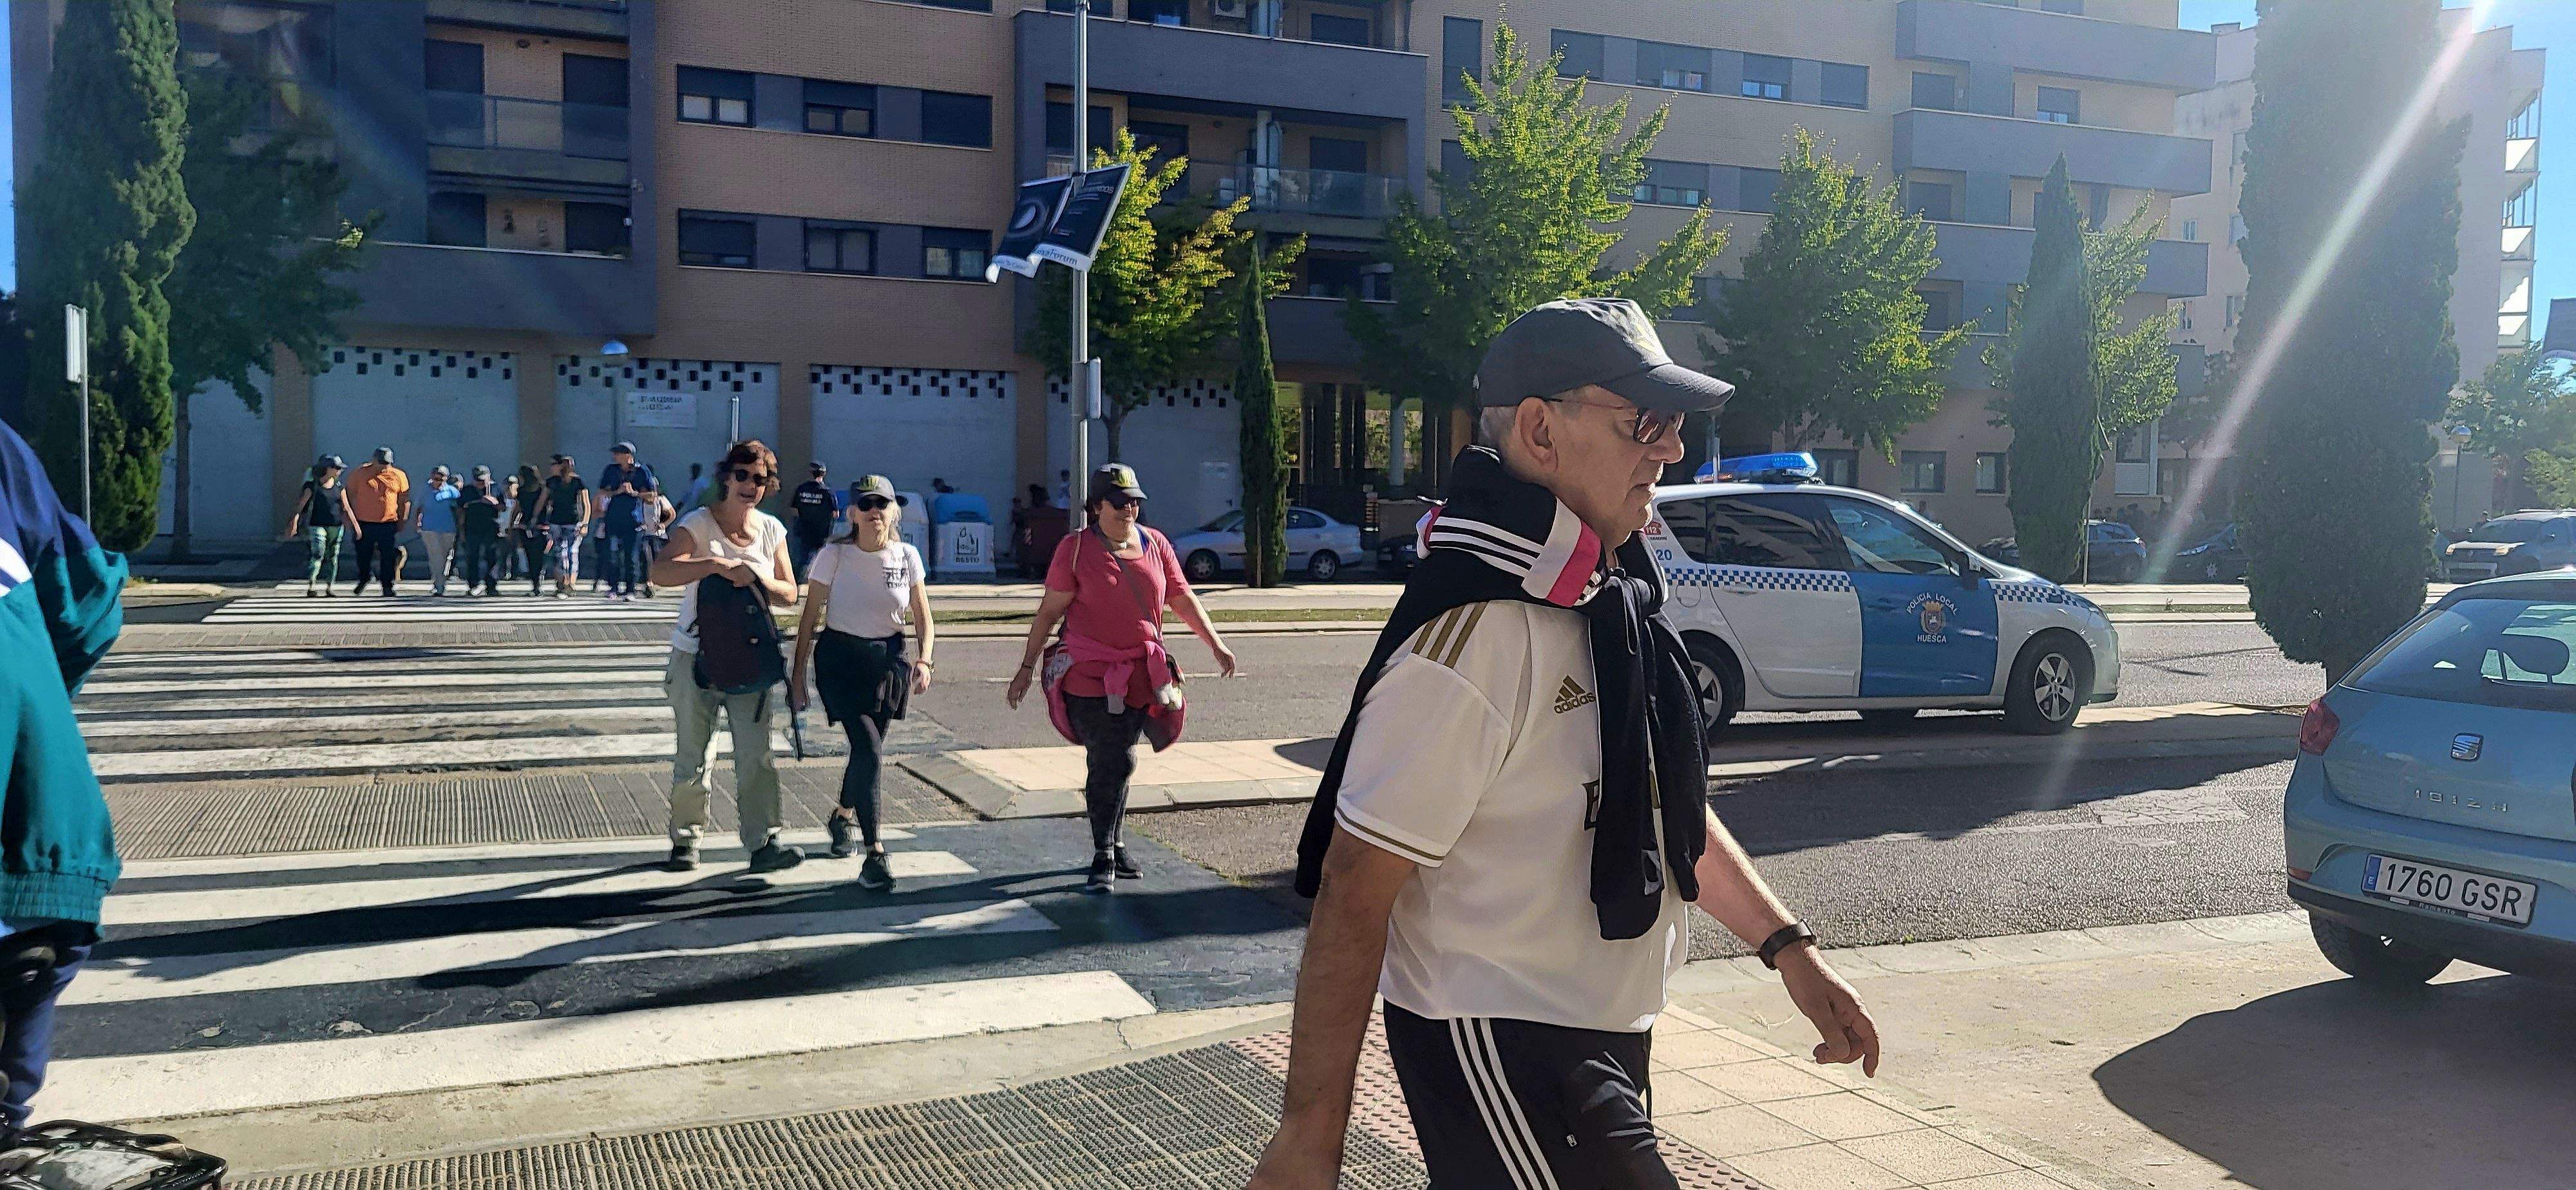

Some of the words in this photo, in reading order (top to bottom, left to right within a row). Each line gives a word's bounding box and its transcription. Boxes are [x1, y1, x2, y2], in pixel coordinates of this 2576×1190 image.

[1655, 549, 1673, 561] 20
[1935, 592, 1959, 616] LOCAL
[1917, 634, 1947, 643] HUESCA
[1554, 692, 1596, 714] adidas
[2367, 876, 2374, 886] E
[2387, 863, 2452, 901] 1760
[2461, 878, 2523, 917] GSR
